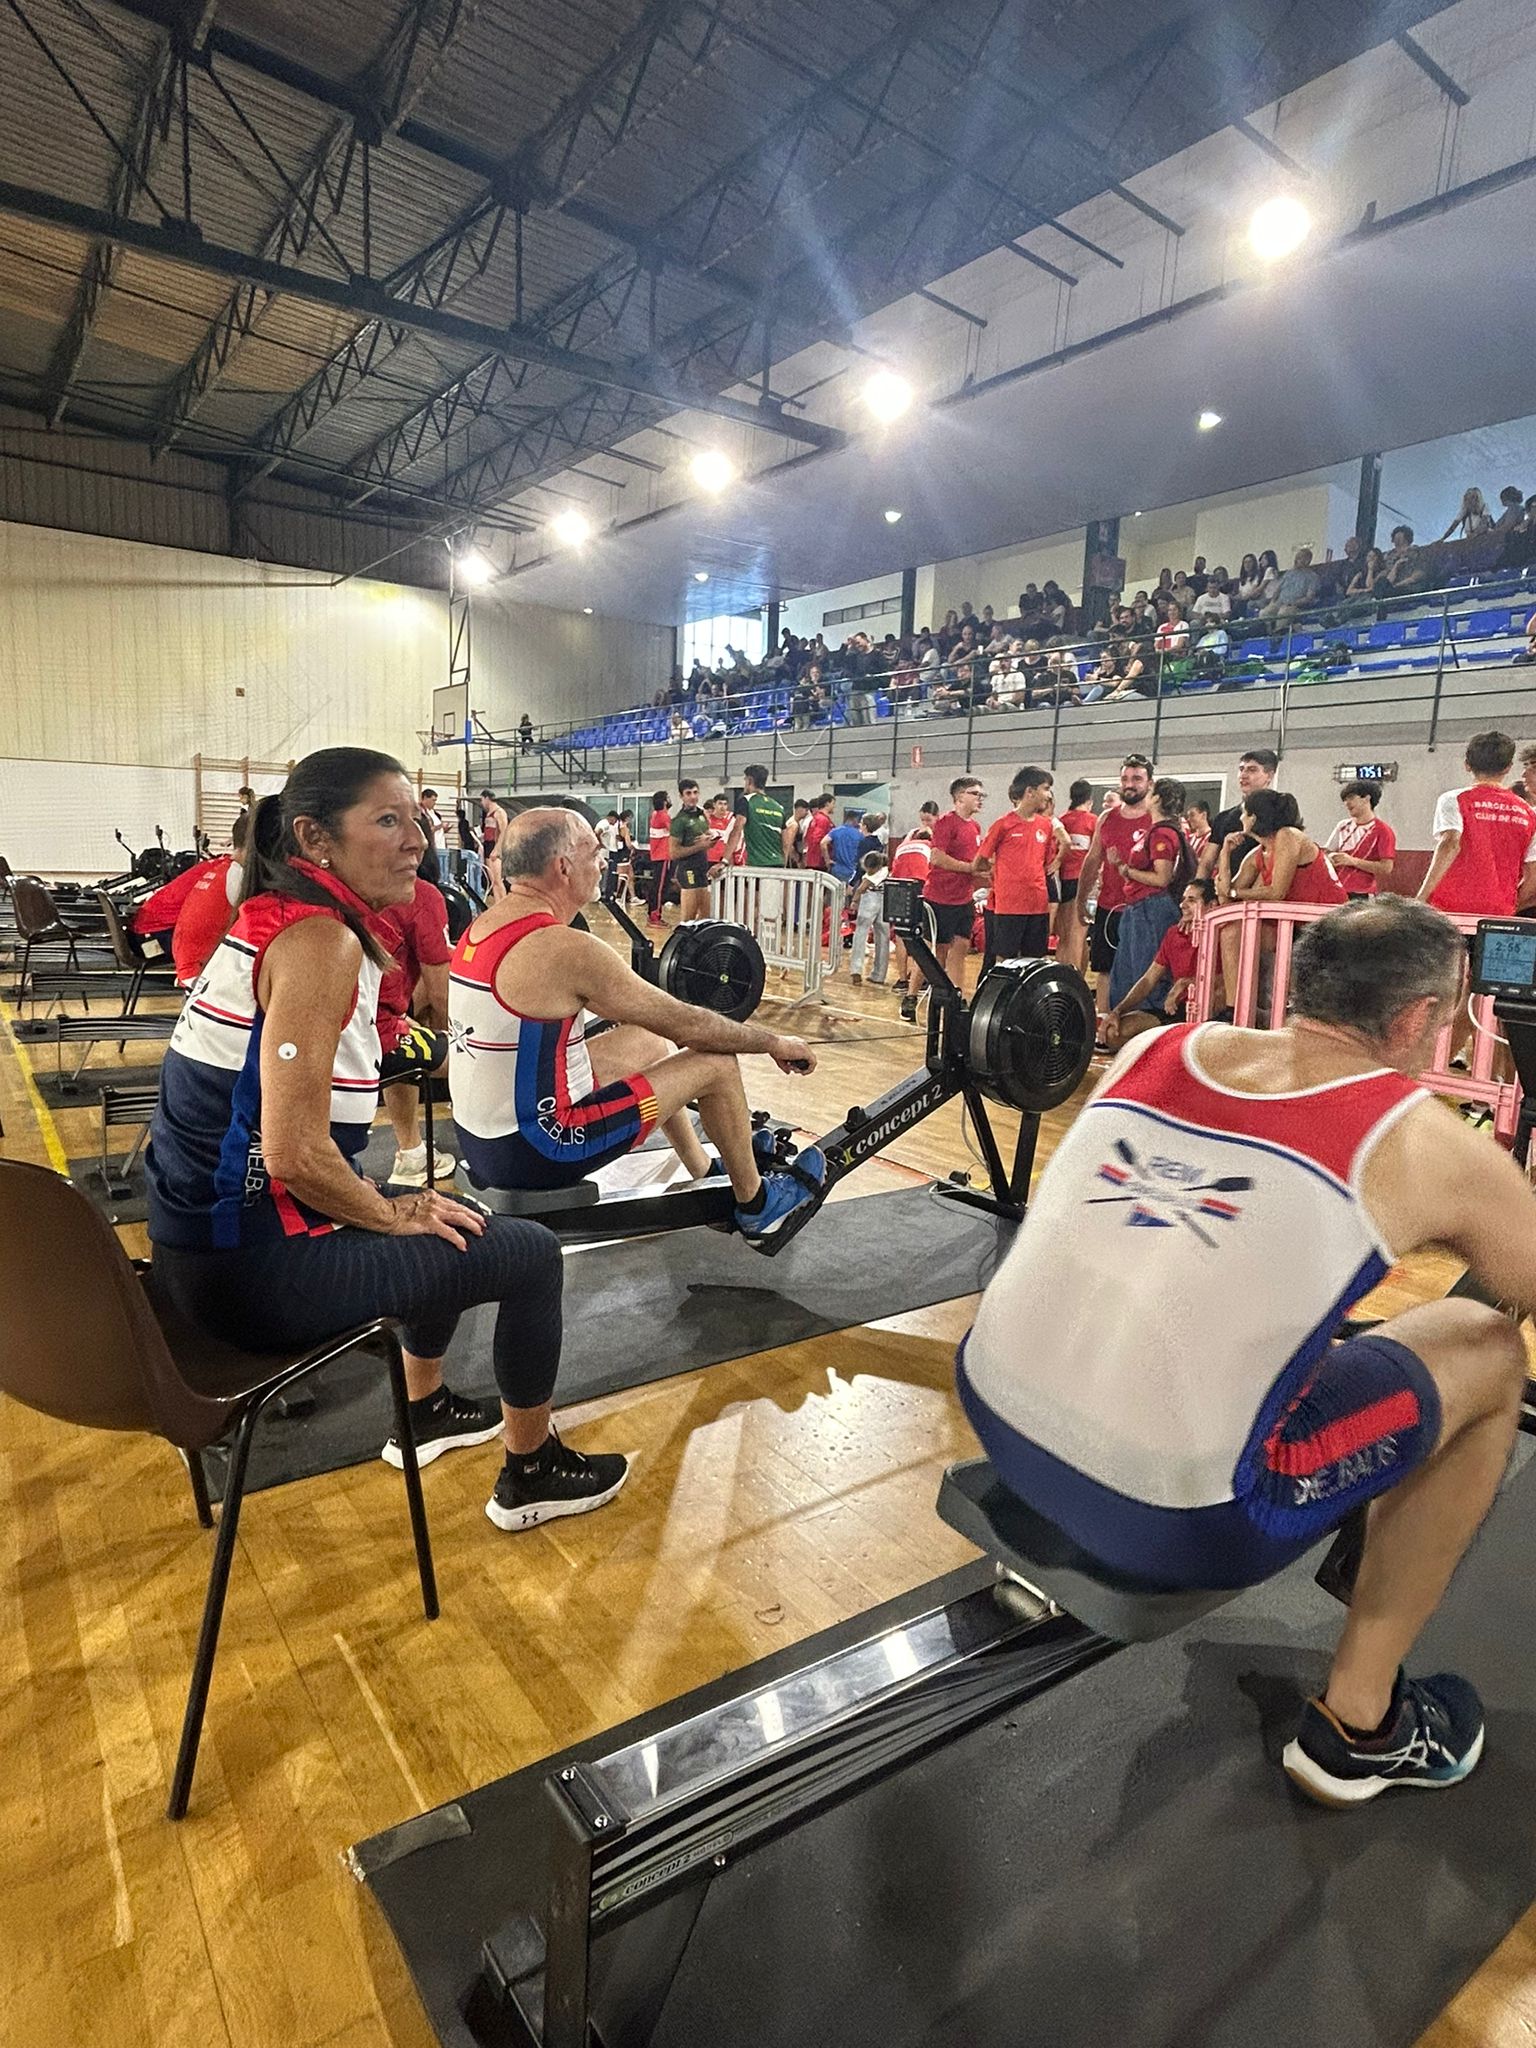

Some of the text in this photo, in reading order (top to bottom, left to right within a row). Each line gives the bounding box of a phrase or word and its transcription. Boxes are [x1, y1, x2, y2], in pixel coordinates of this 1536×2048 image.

[857, 1094, 931, 1154] concept
[931, 1084, 943, 1100] 2
[625, 1860, 682, 1894] concept
[682, 1853, 692, 1864] 2
